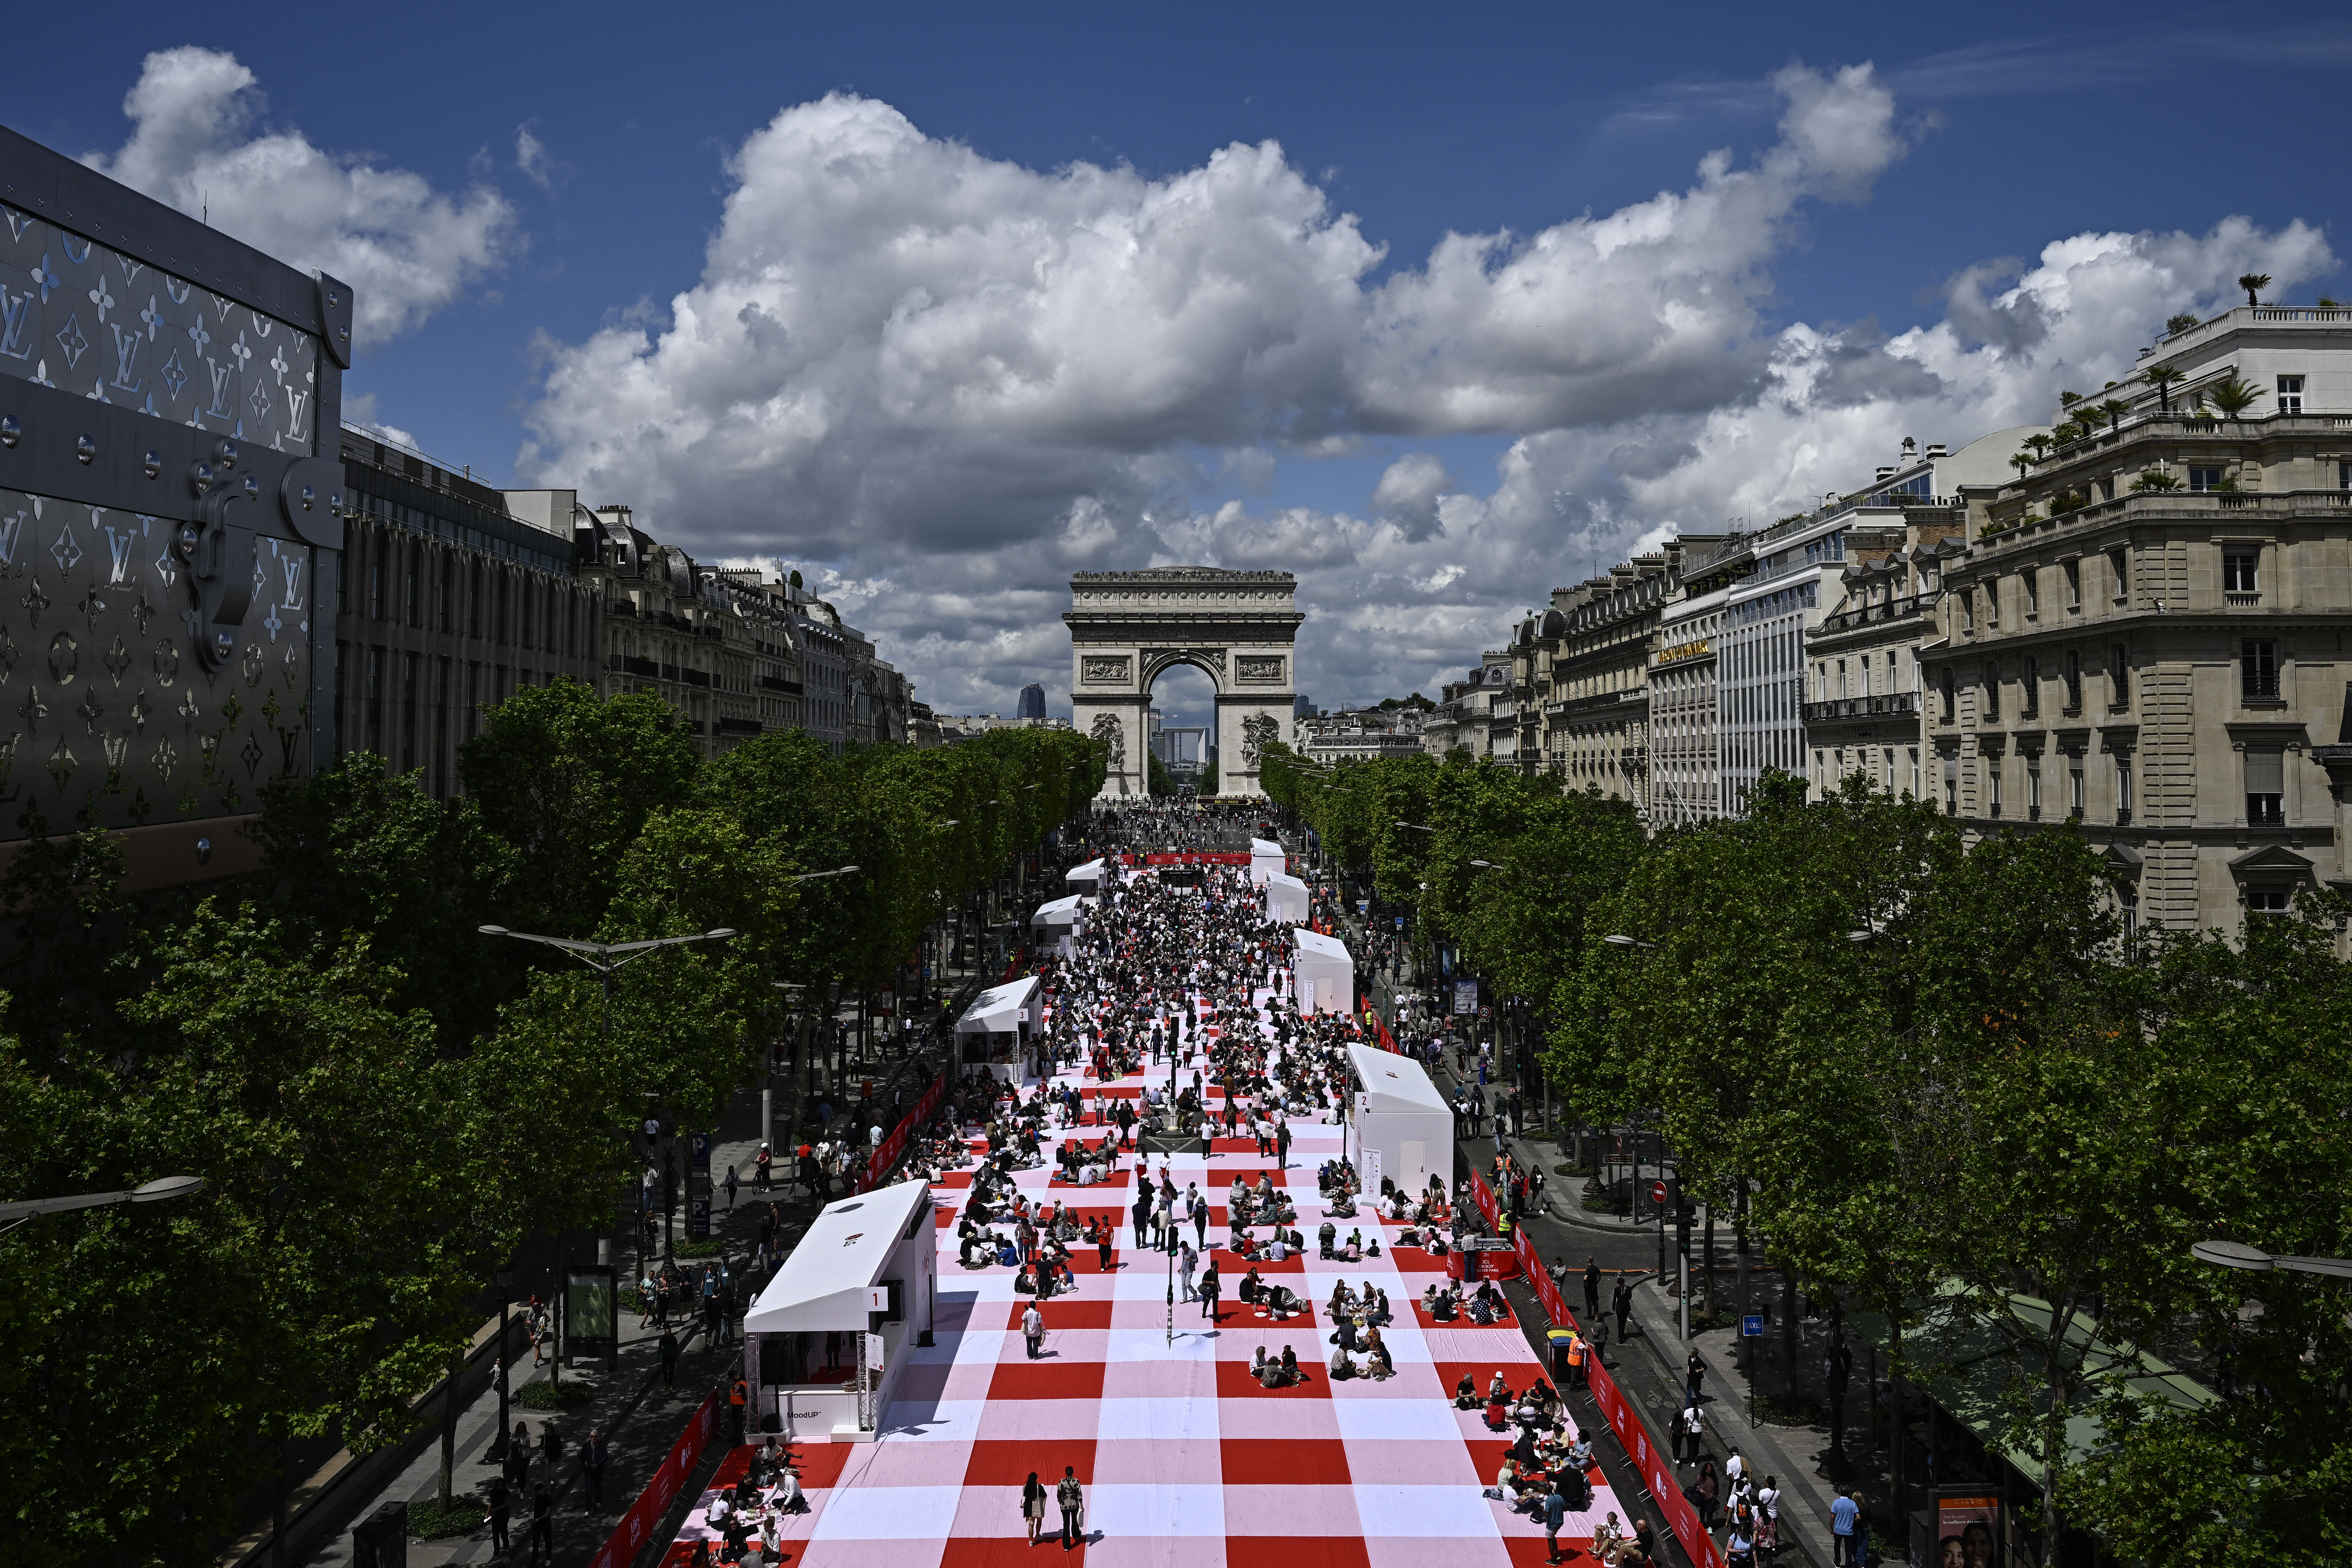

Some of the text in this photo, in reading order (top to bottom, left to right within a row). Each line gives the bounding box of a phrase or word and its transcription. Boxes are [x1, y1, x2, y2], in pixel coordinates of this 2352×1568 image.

[109, 323, 143, 393] LV
[205, 357, 234, 420] LV
[284, 385, 308, 443] LV
[103, 525, 137, 592] LV
[280, 555, 303, 611] LV
[1362, 1096, 1366, 1105] 2
[693, 1138, 706, 1154] P
[693, 1202, 702, 1215] P
[873, 1293, 877, 1306] 1
[685, 1442, 691, 1459] LG
[1661, 1481, 1667, 1500] LG
[630, 1513, 640, 1534] Life's
